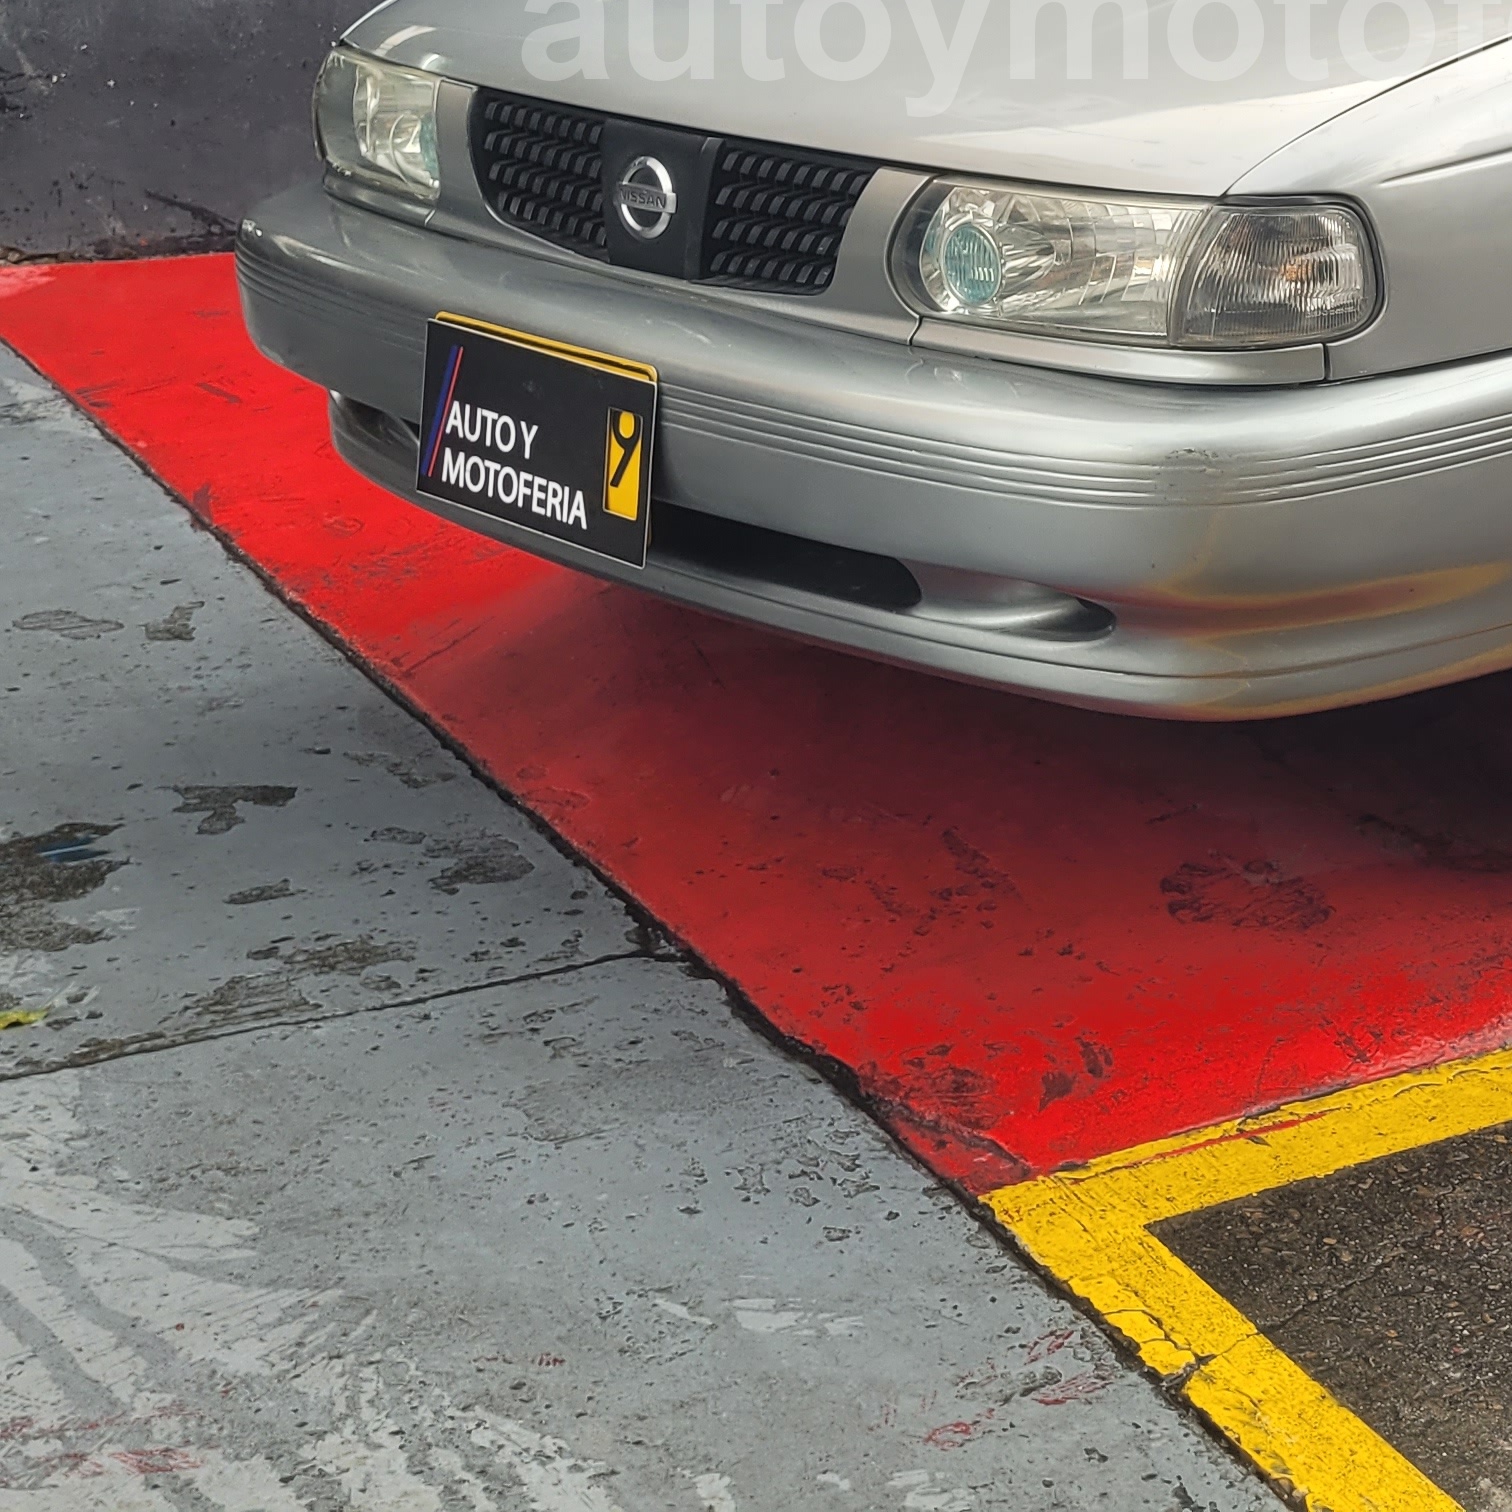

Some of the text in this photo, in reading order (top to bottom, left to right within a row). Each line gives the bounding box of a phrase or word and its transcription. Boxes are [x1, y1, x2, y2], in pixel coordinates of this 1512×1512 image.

[620, 188, 667, 209] NISSAN
[445, 400, 539, 460] AUTO Y
[441, 447, 588, 530] MOTOFERIA
